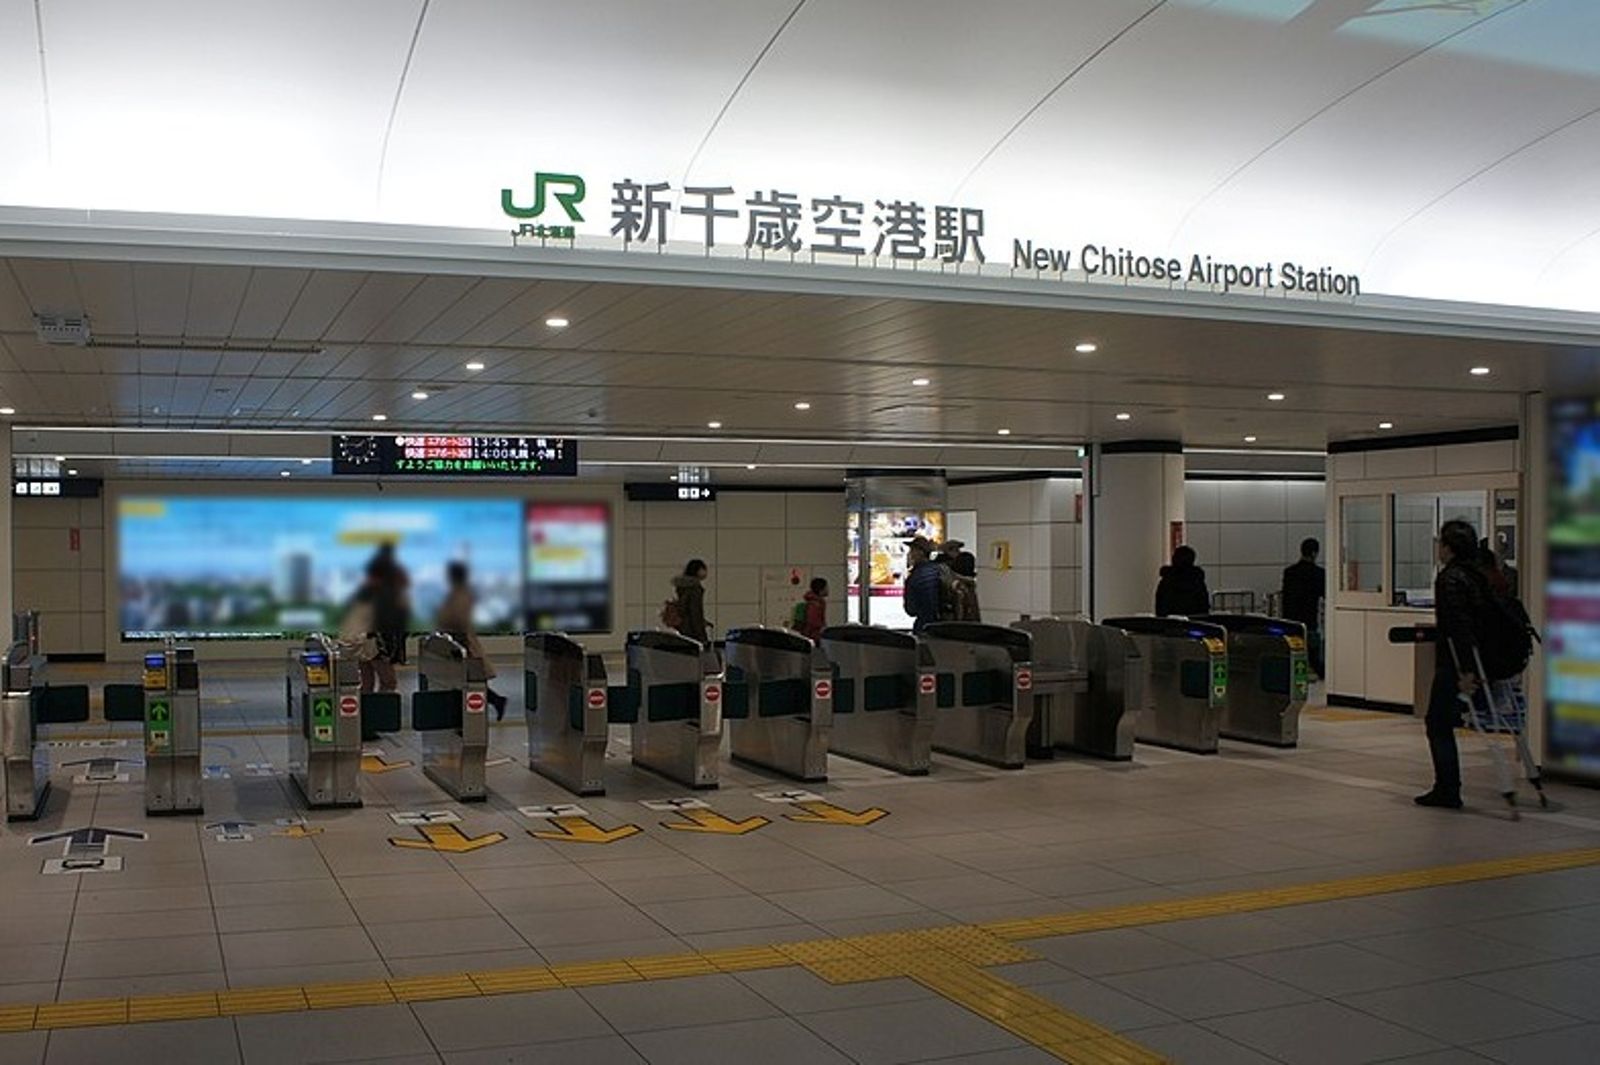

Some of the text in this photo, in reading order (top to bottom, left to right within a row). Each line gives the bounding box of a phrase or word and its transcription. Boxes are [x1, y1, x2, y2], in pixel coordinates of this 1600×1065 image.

[501, 172, 586, 222] JR
[609, 178, 986, 265] 新千歳空港駅
[1012, 238, 1361, 296] New Chitose Airport Station
